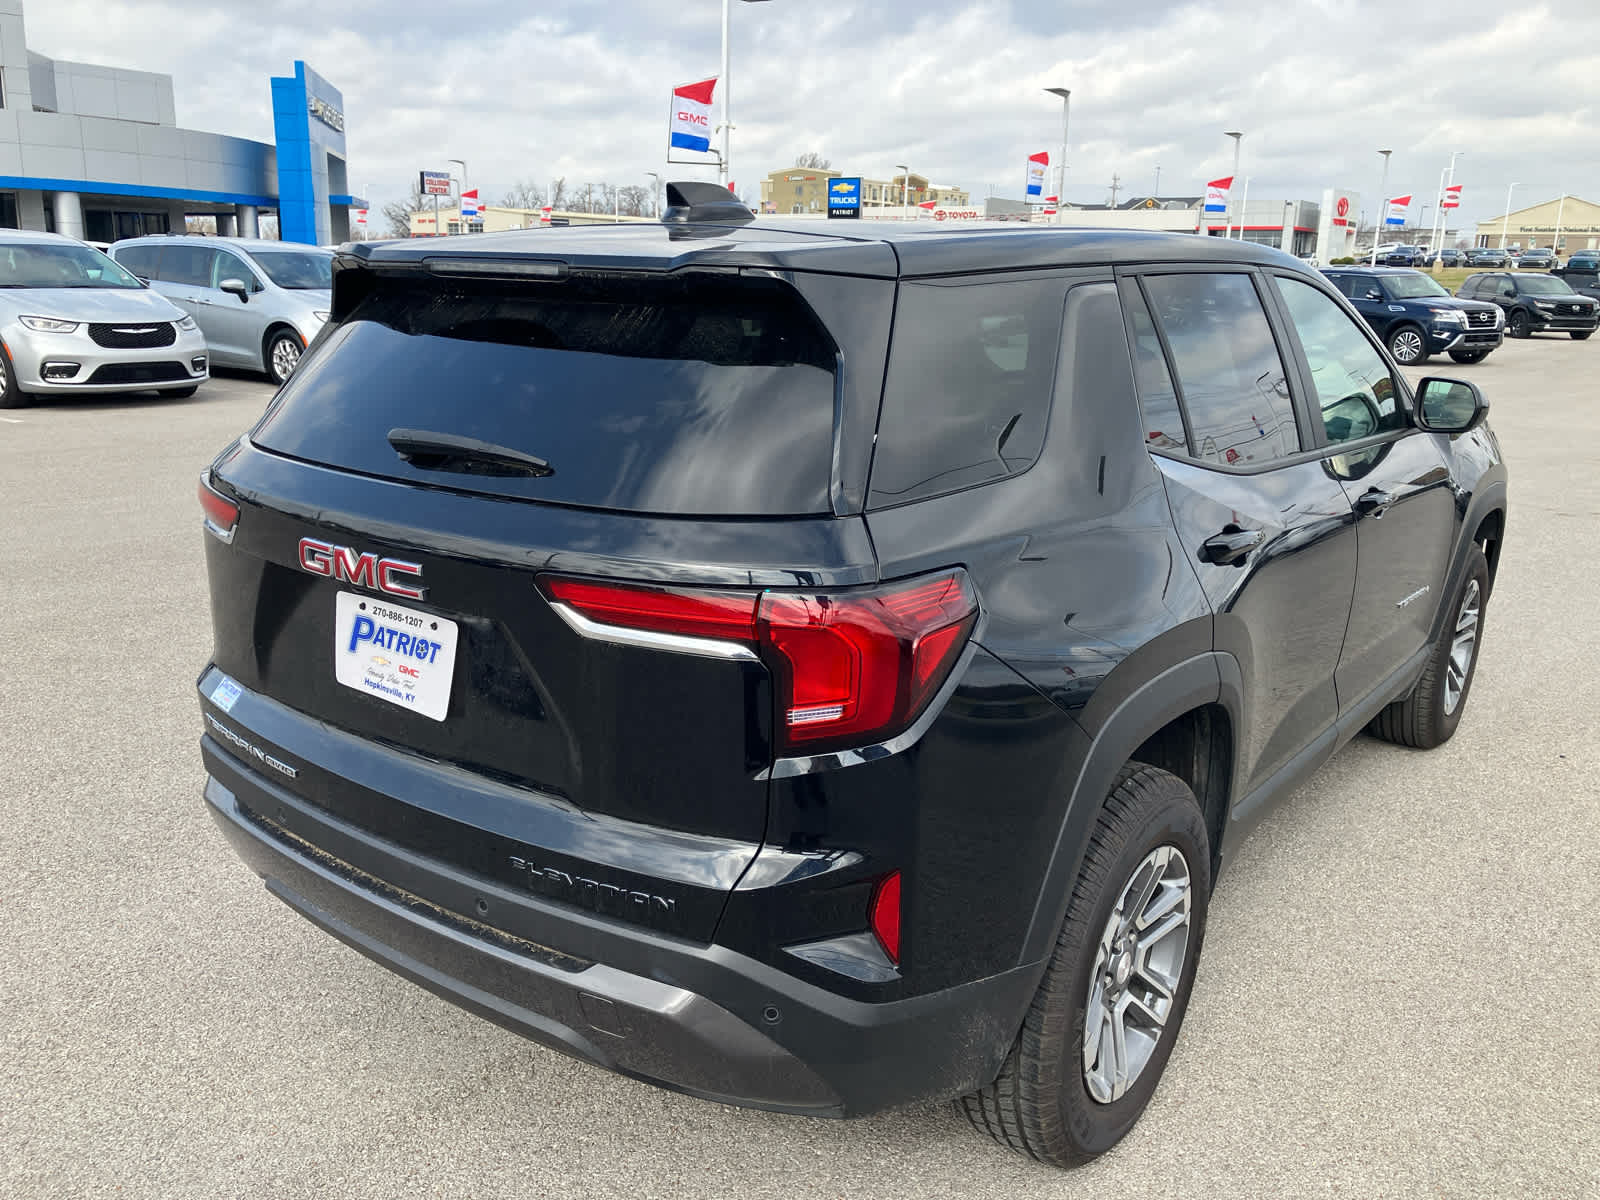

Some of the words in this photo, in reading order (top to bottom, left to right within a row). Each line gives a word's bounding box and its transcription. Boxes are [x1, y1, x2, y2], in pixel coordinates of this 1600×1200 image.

[678, 111, 708, 126] GMC
[829, 196, 857, 204] TRUCKS
[948, 211, 977, 219] TOYOTA
[299, 537, 424, 600] GMC
[372, 606, 424, 628] 270-886-1207
[348, 614, 442, 664] PATRIOT
[398, 664, 420, 679] GMC
[405, 693, 416, 703] KY
[509, 856, 676, 914] ELEVATION
